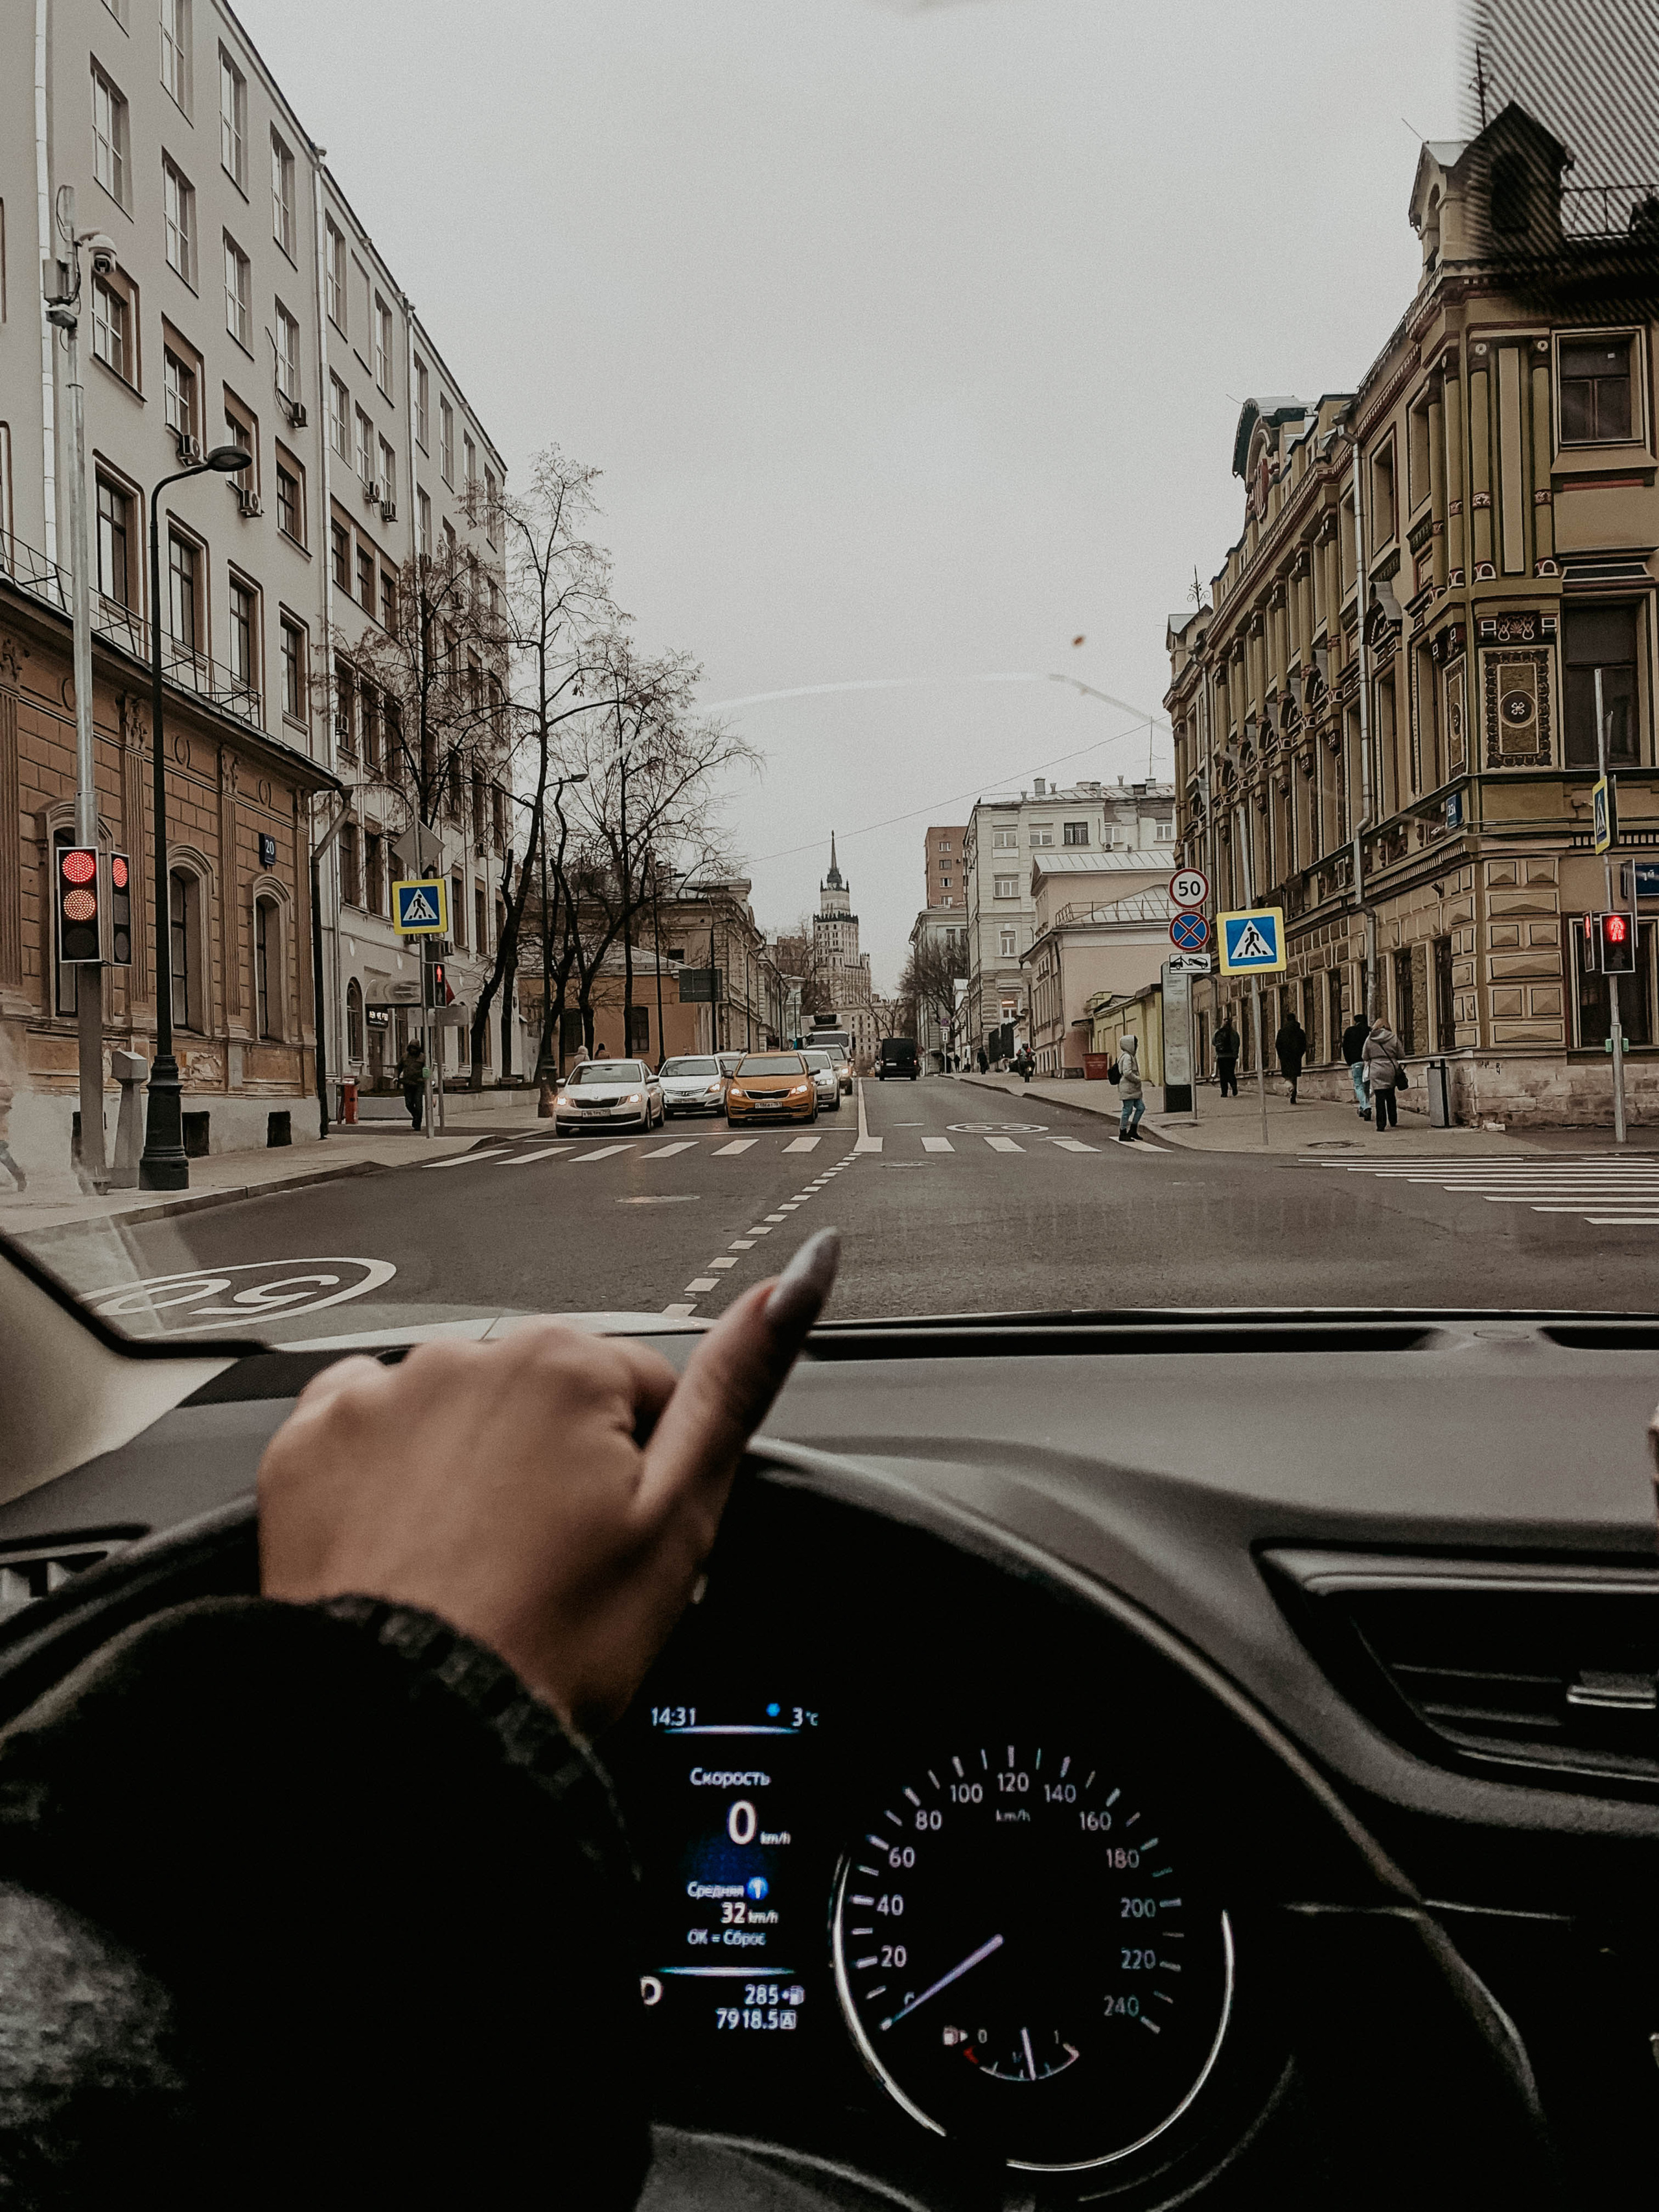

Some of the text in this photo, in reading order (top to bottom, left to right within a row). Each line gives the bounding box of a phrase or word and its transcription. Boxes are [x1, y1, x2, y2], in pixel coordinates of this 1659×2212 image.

[266, 839, 274, 855] 20
[1178, 881, 1201, 897] 50
[96, 1274, 340, 1316] 50
[651, 1707, 696, 1727] 14:31
[690, 1767, 771, 1789] Скорость
[997, 1773, 1029, 1791] 120
[951, 1784, 982, 1803] 100
[1045, 1784, 1076, 1803] 140
[727, 1800, 791, 1845] 0 km/h
[916, 1810, 942, 1830] 80
[996, 1810, 1030, 1822] km/h
[1080, 1811, 1112, 1831] 160
[889, 1847, 915, 1868] 60
[1107, 1848, 1140, 1869] 180
[721, 1902, 780, 1924] 32 km/h
[877, 1894, 903, 1916] 40
[1121, 1898, 1156, 1918] 200
[881, 1945, 907, 1968] 20
[1121, 1948, 1156, 1969] 220
[745, 1984, 779, 2005] 285
[1104, 1995, 1139, 2016] 240
[715, 2008, 778, 2029] 7918.5
[977, 2029, 988, 2043] 0
